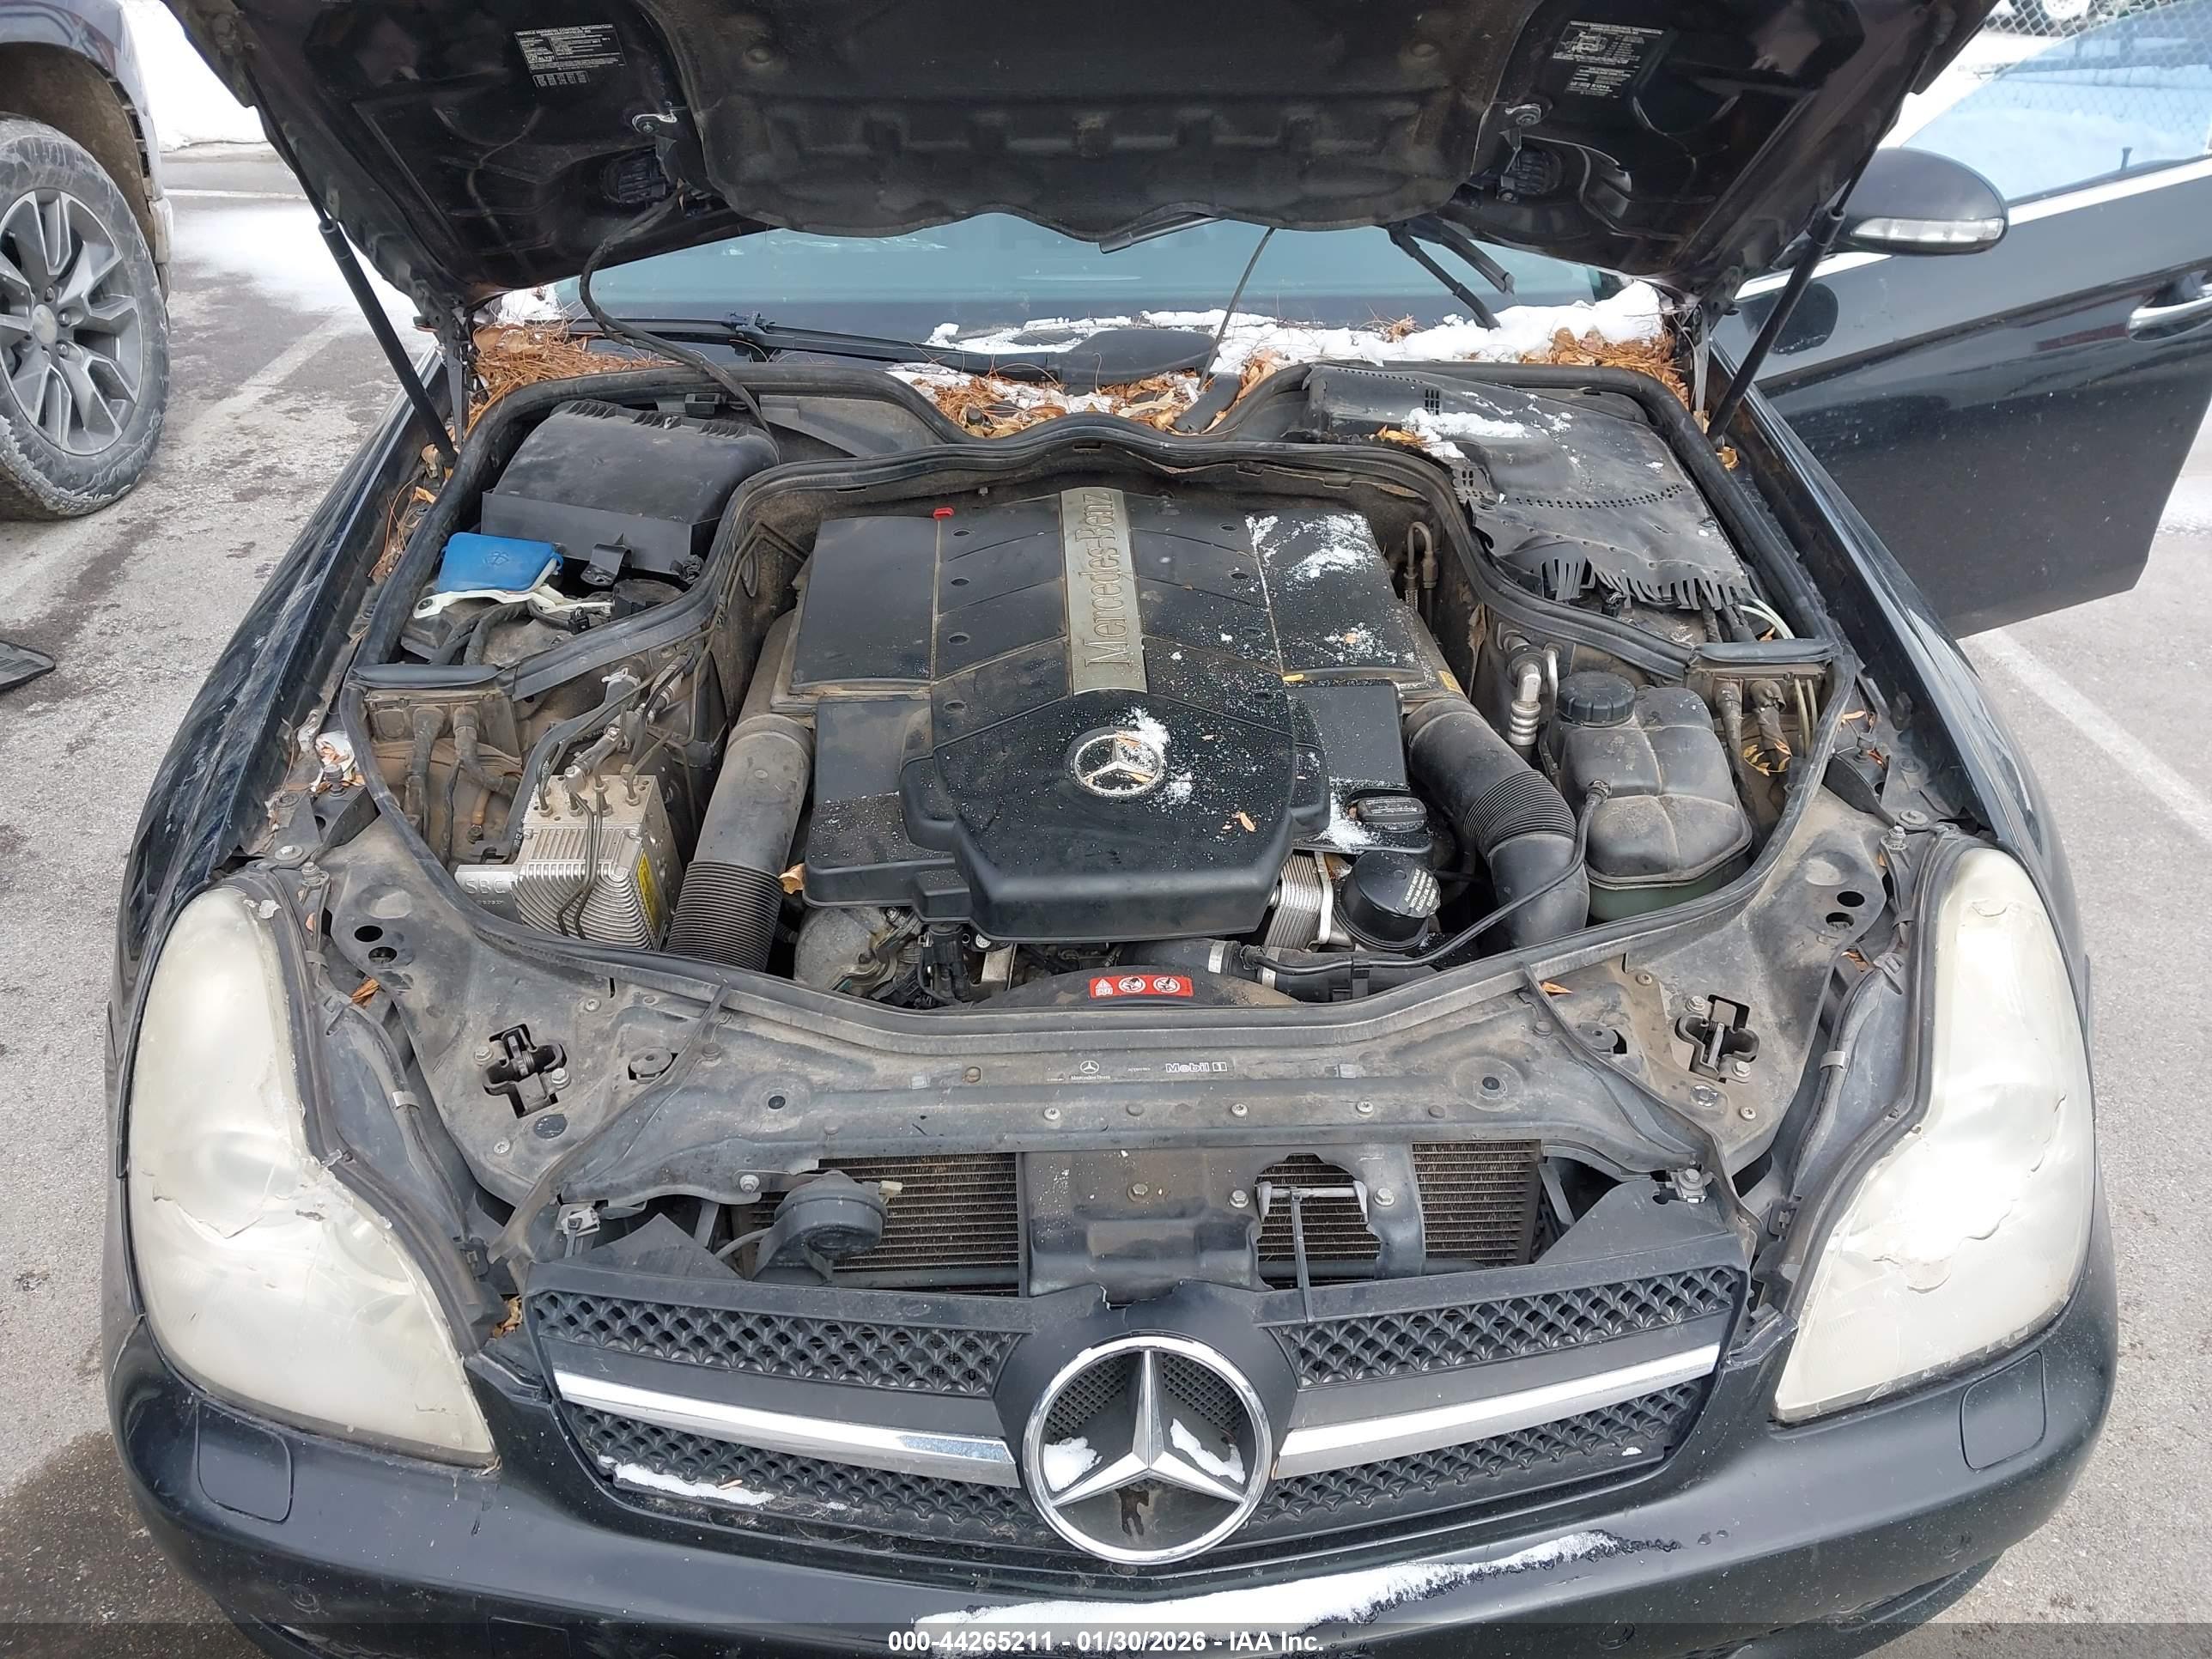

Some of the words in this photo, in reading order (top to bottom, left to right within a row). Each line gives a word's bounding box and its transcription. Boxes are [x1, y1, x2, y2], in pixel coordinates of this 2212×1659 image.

[1075, 492, 1133, 667] Mercedes-Benz
[465, 878, 506, 894] SBC
[1165, 1062, 1210, 1073] Mobil
